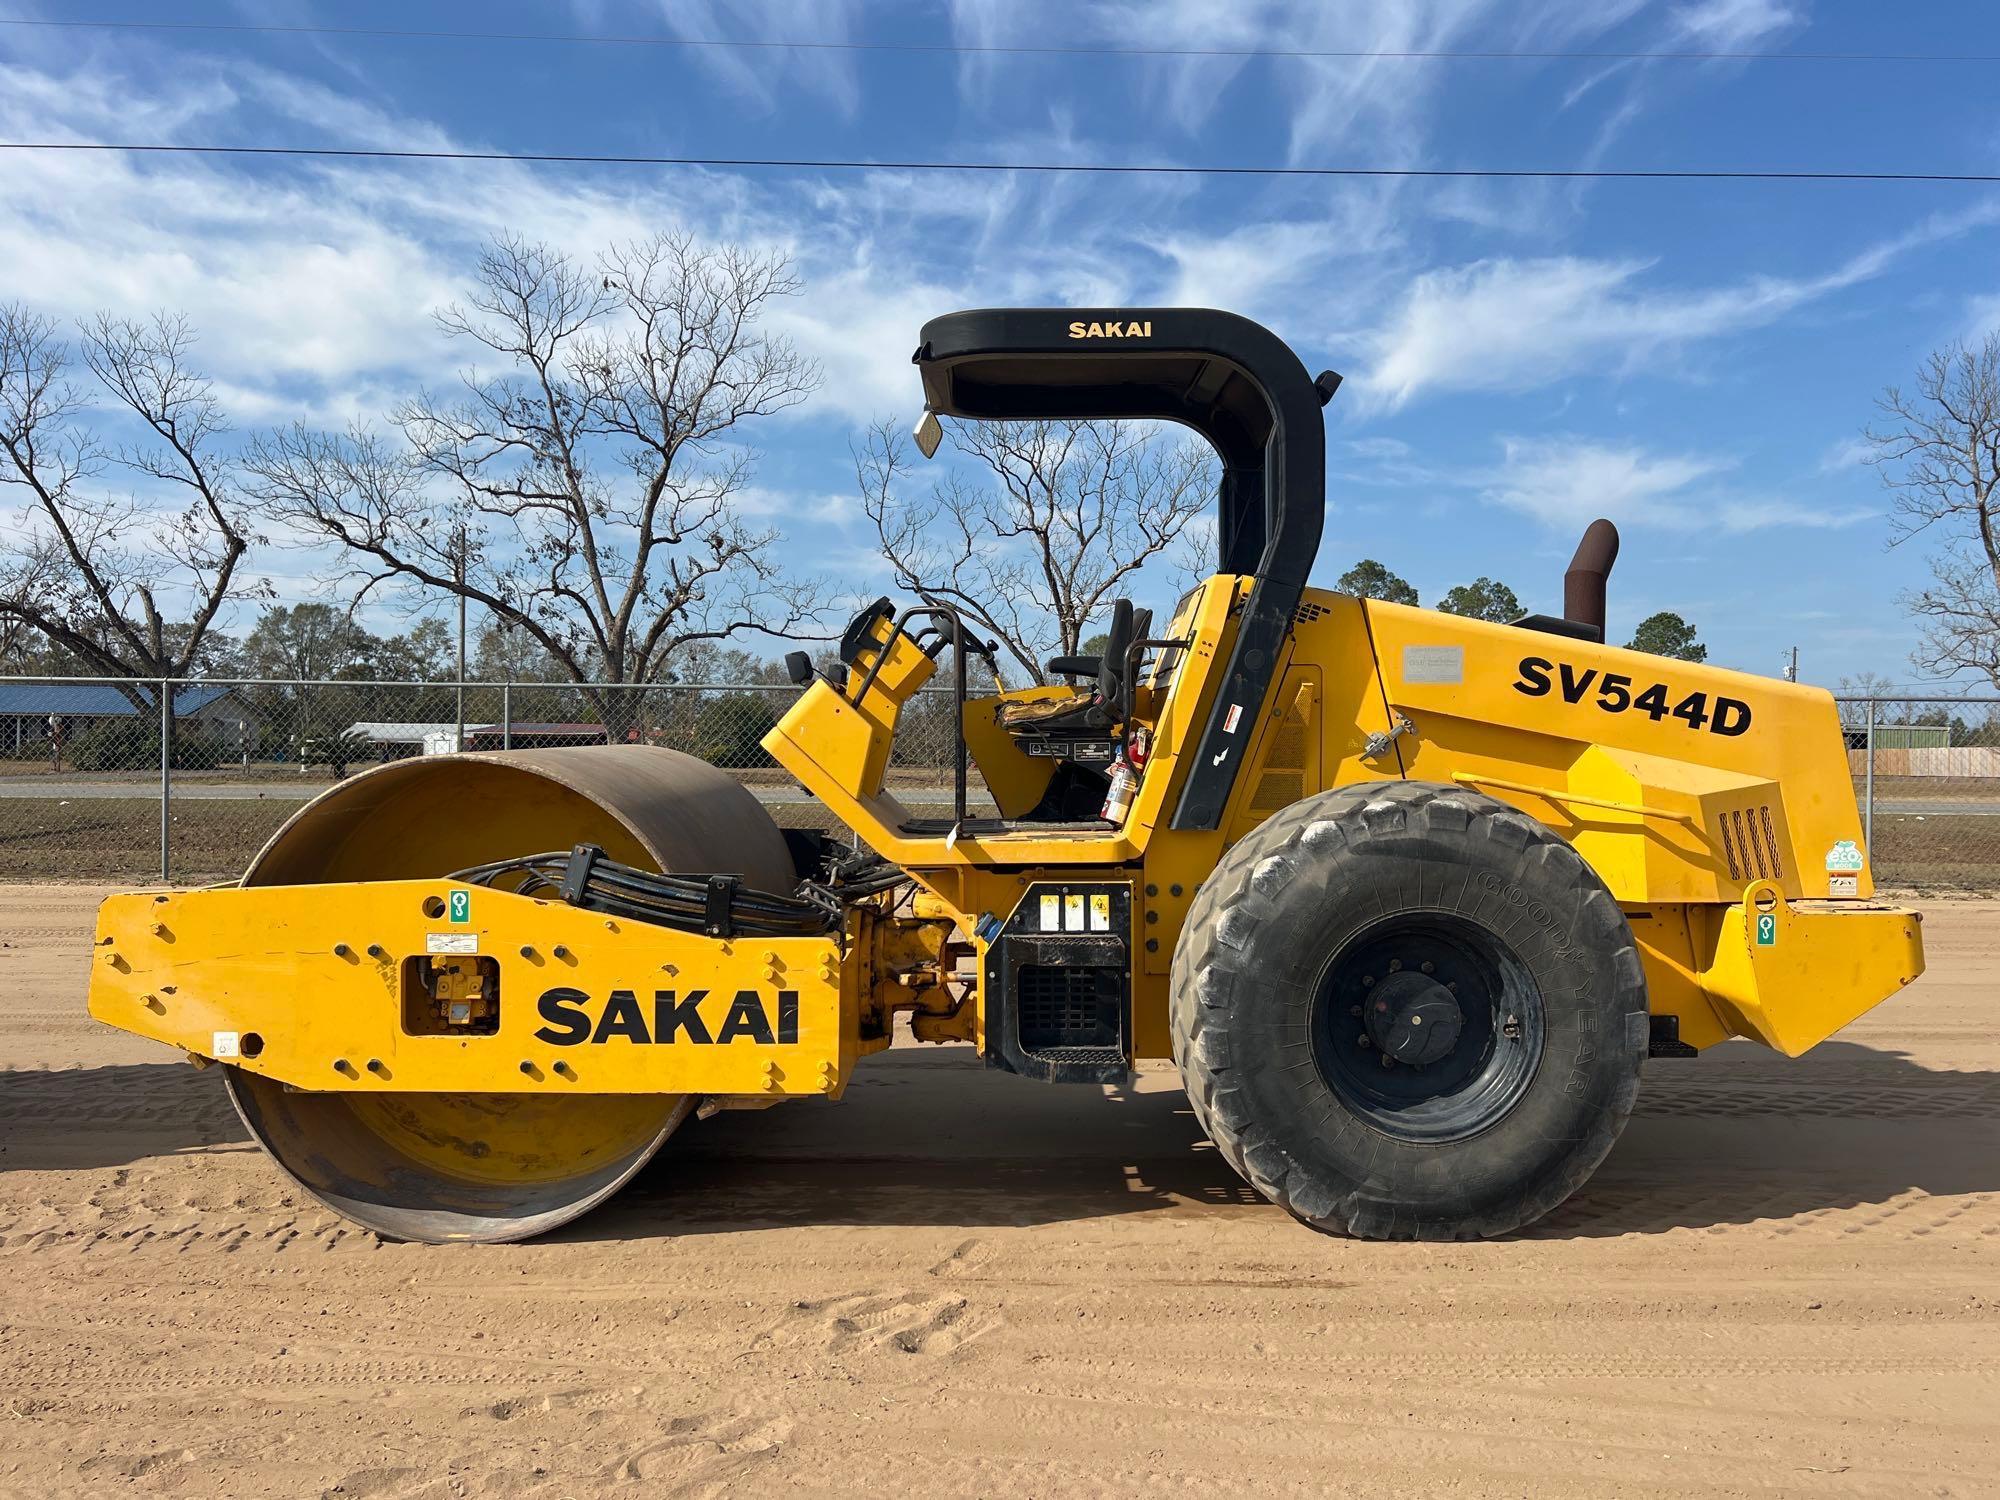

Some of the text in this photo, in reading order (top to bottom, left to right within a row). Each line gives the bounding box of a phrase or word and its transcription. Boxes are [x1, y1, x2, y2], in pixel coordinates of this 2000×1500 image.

[1068, 321, 1152, 339] SAKAI
[1512, 656, 1752, 737] SV544D
[533, 987, 799, 1046] SAKAI
